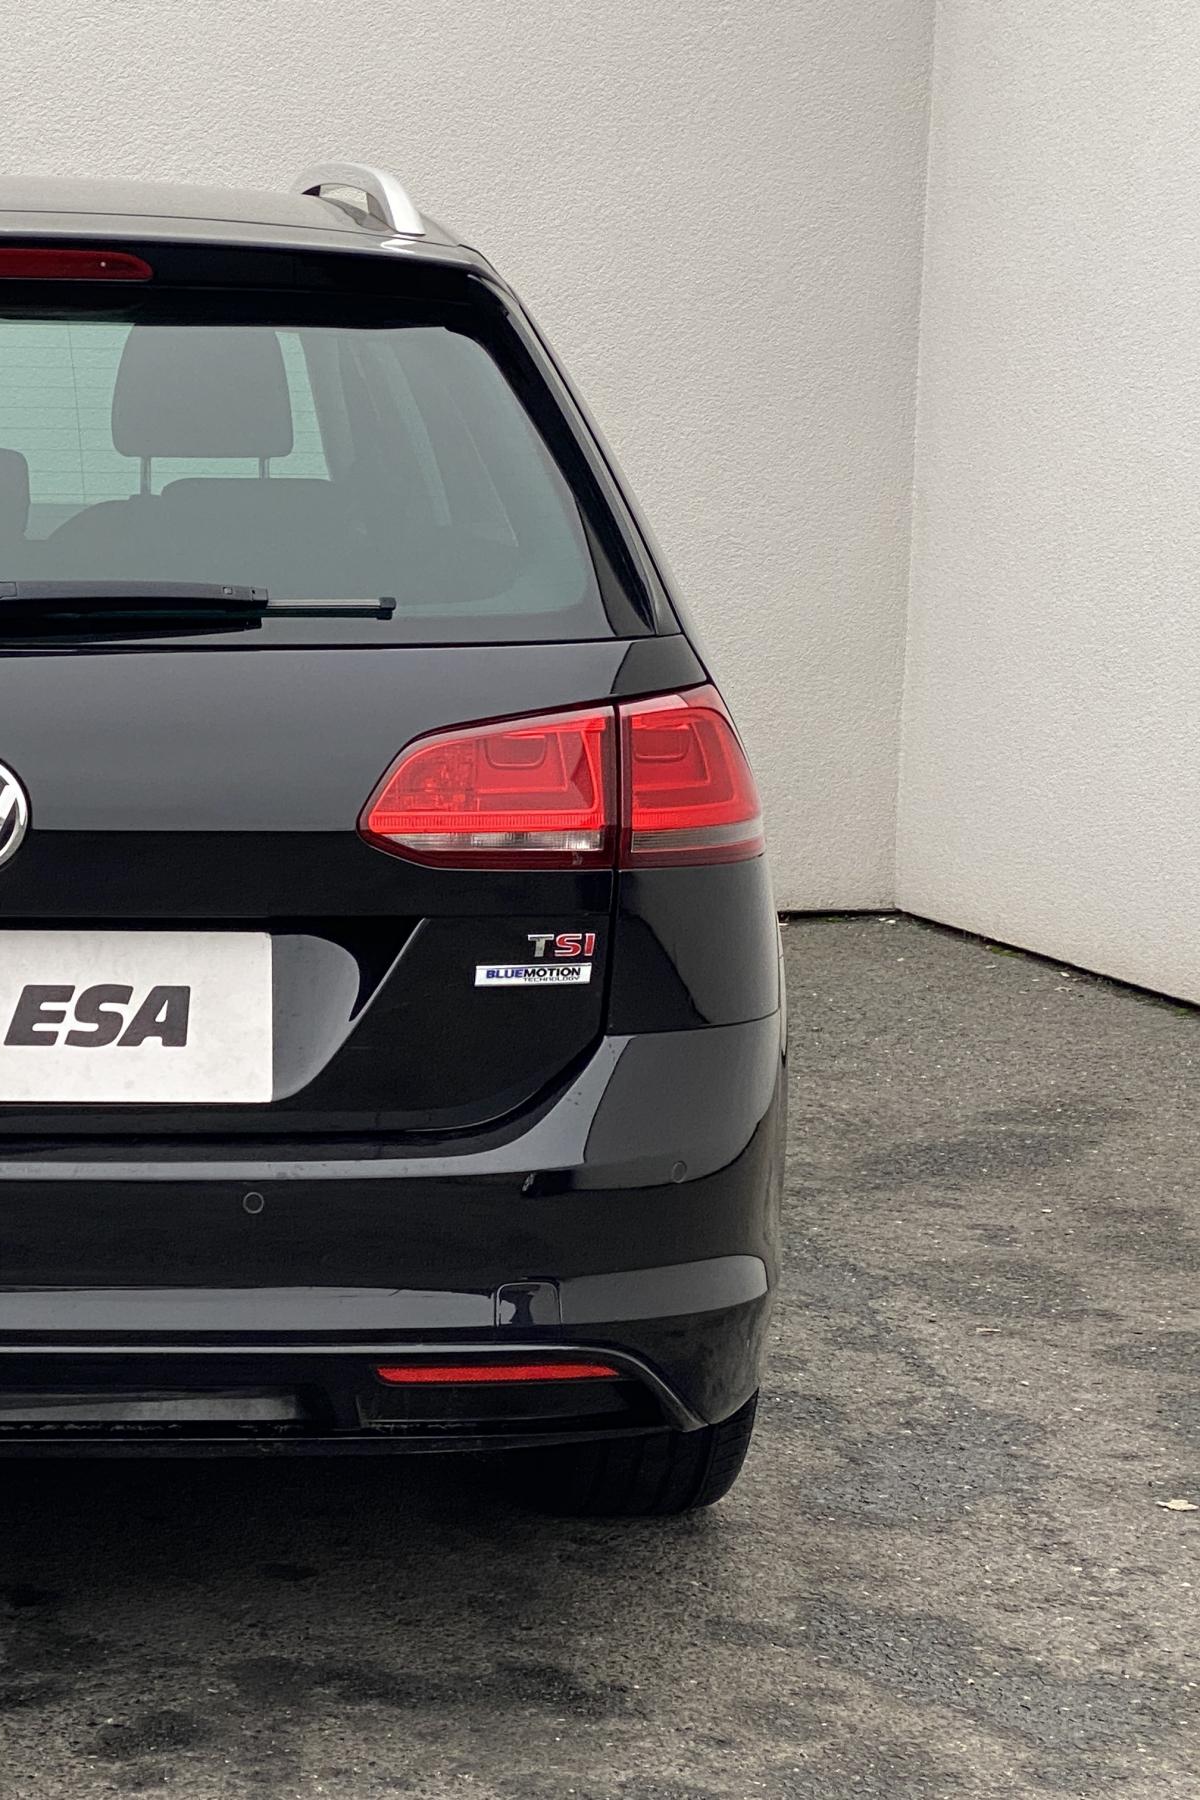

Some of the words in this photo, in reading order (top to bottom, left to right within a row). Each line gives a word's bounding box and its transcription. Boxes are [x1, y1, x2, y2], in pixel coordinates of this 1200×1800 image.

[527, 933, 596, 957] TSI
[486, 967, 581, 979] BLUEMOTION
[3, 983, 192, 1048] ESA
